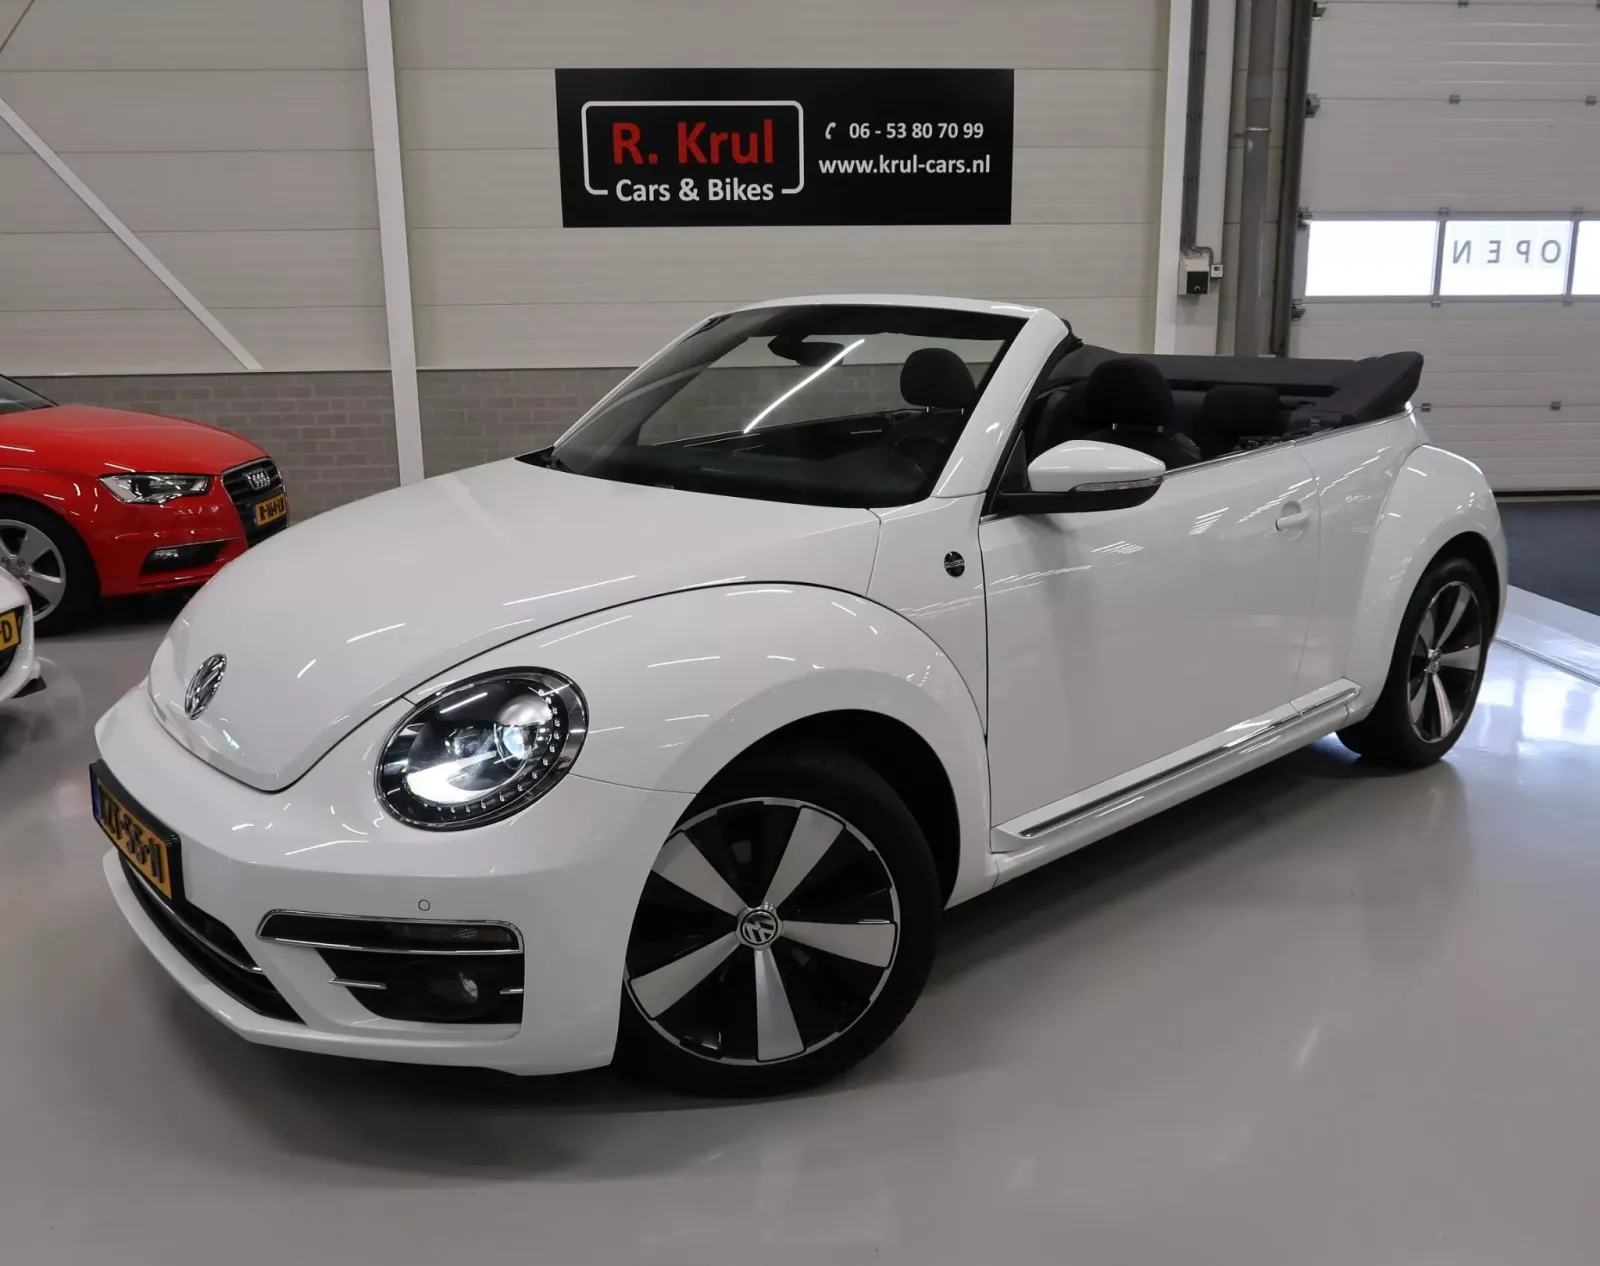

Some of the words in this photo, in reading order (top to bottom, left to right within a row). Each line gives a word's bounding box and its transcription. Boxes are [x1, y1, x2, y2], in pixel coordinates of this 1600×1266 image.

[612, 122, 658, 164] R.
[677, 119, 774, 164] Krul
[849, 122, 871, 139] 06
[886, 122, 907, 139] 53
[911, 122, 933, 139] 80
[937, 122, 959, 139] 70
[962, 122, 984, 139] 99
[818, 153, 991, 174] www.krul-cars.nl
[615, 178, 671, 202] Cars
[678, 177, 700, 202] &
[708, 176, 774, 201] Bikes
